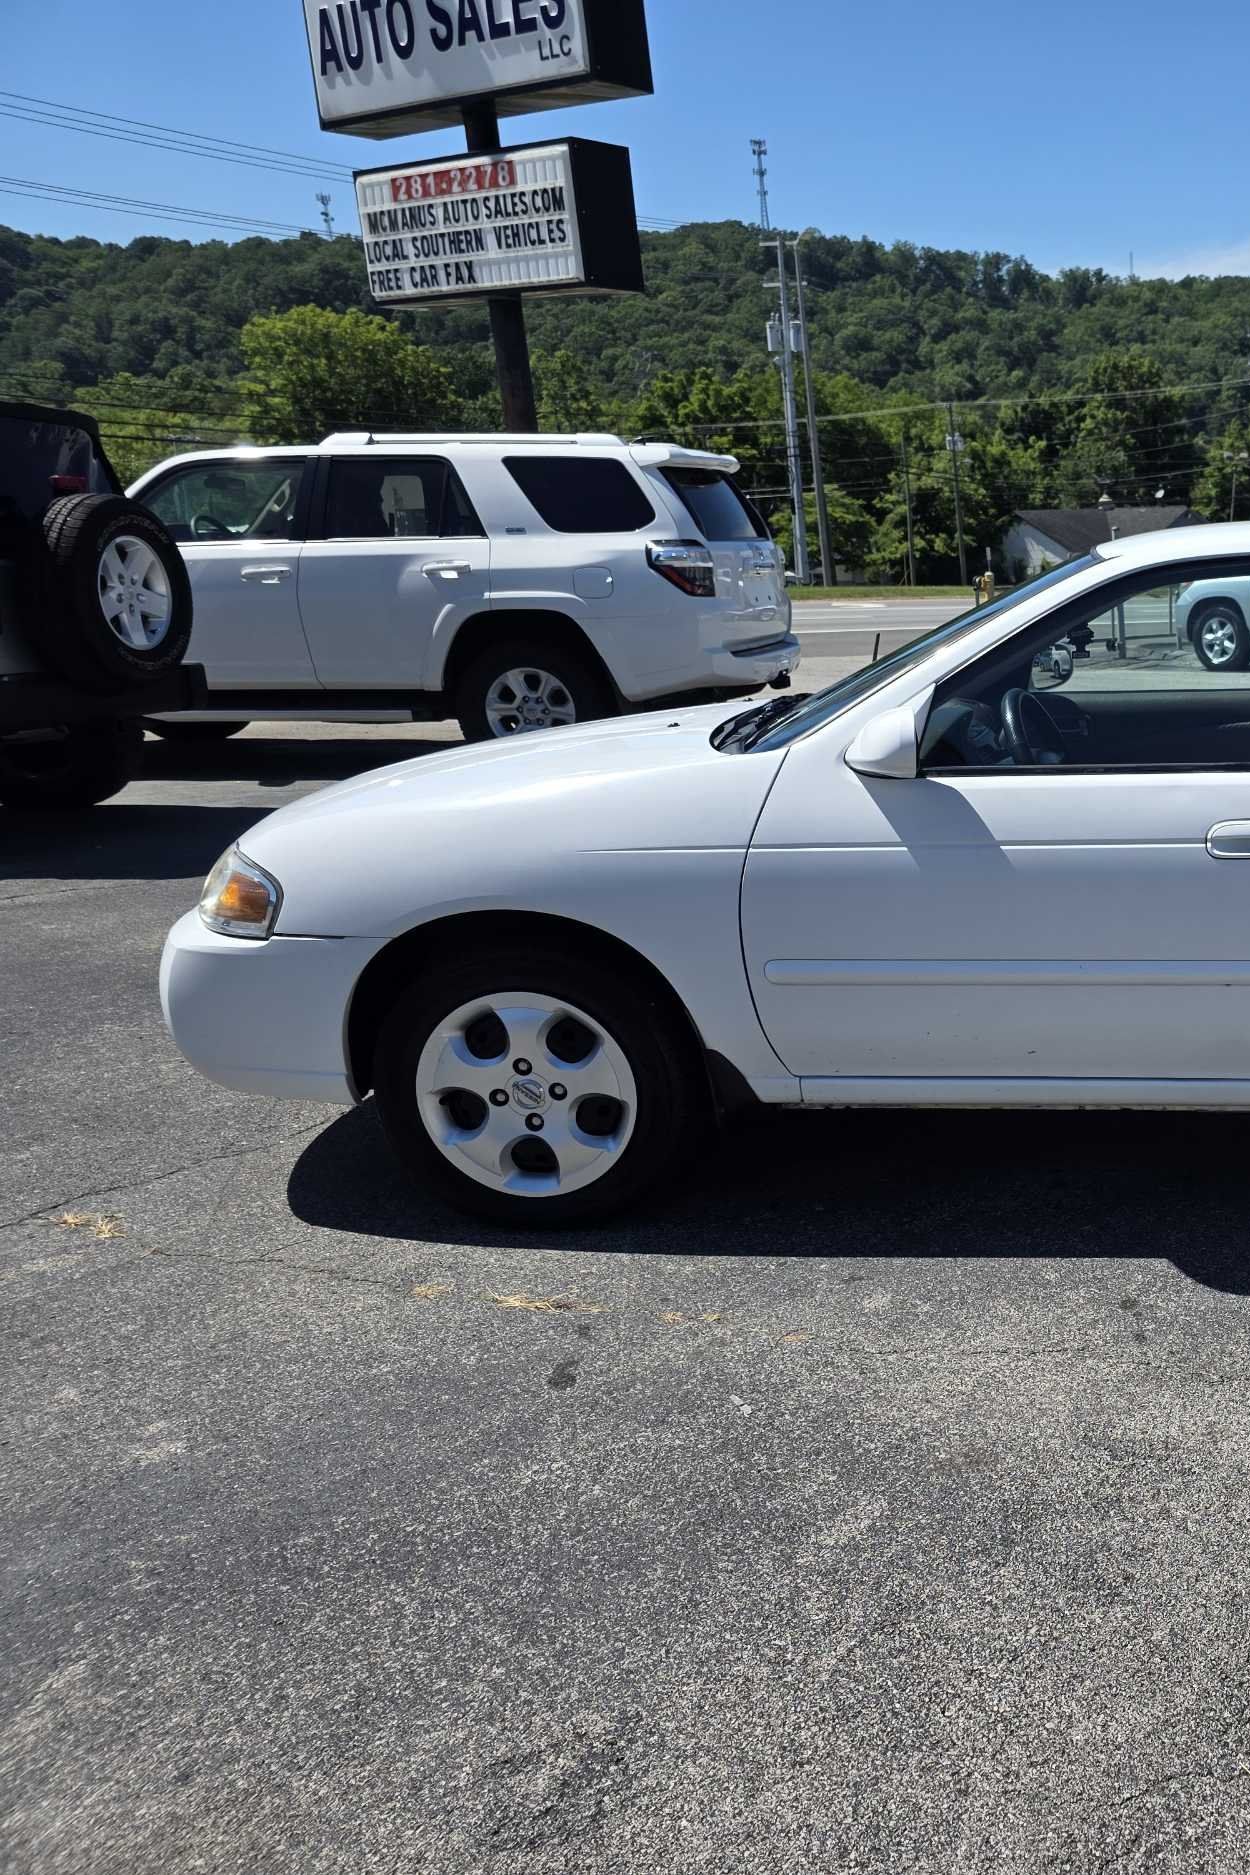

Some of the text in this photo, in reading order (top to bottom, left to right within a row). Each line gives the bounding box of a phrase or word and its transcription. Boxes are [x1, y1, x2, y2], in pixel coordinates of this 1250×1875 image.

[319, 0, 415, 76] AUTO
[538, 34, 572, 61] LLC
[367, 204, 436, 235] MCMANUS
[366, 219, 567, 265] LOCAL SOUTHERN VEHICLES
[370, 260, 477, 293] FREE CAR FAX
